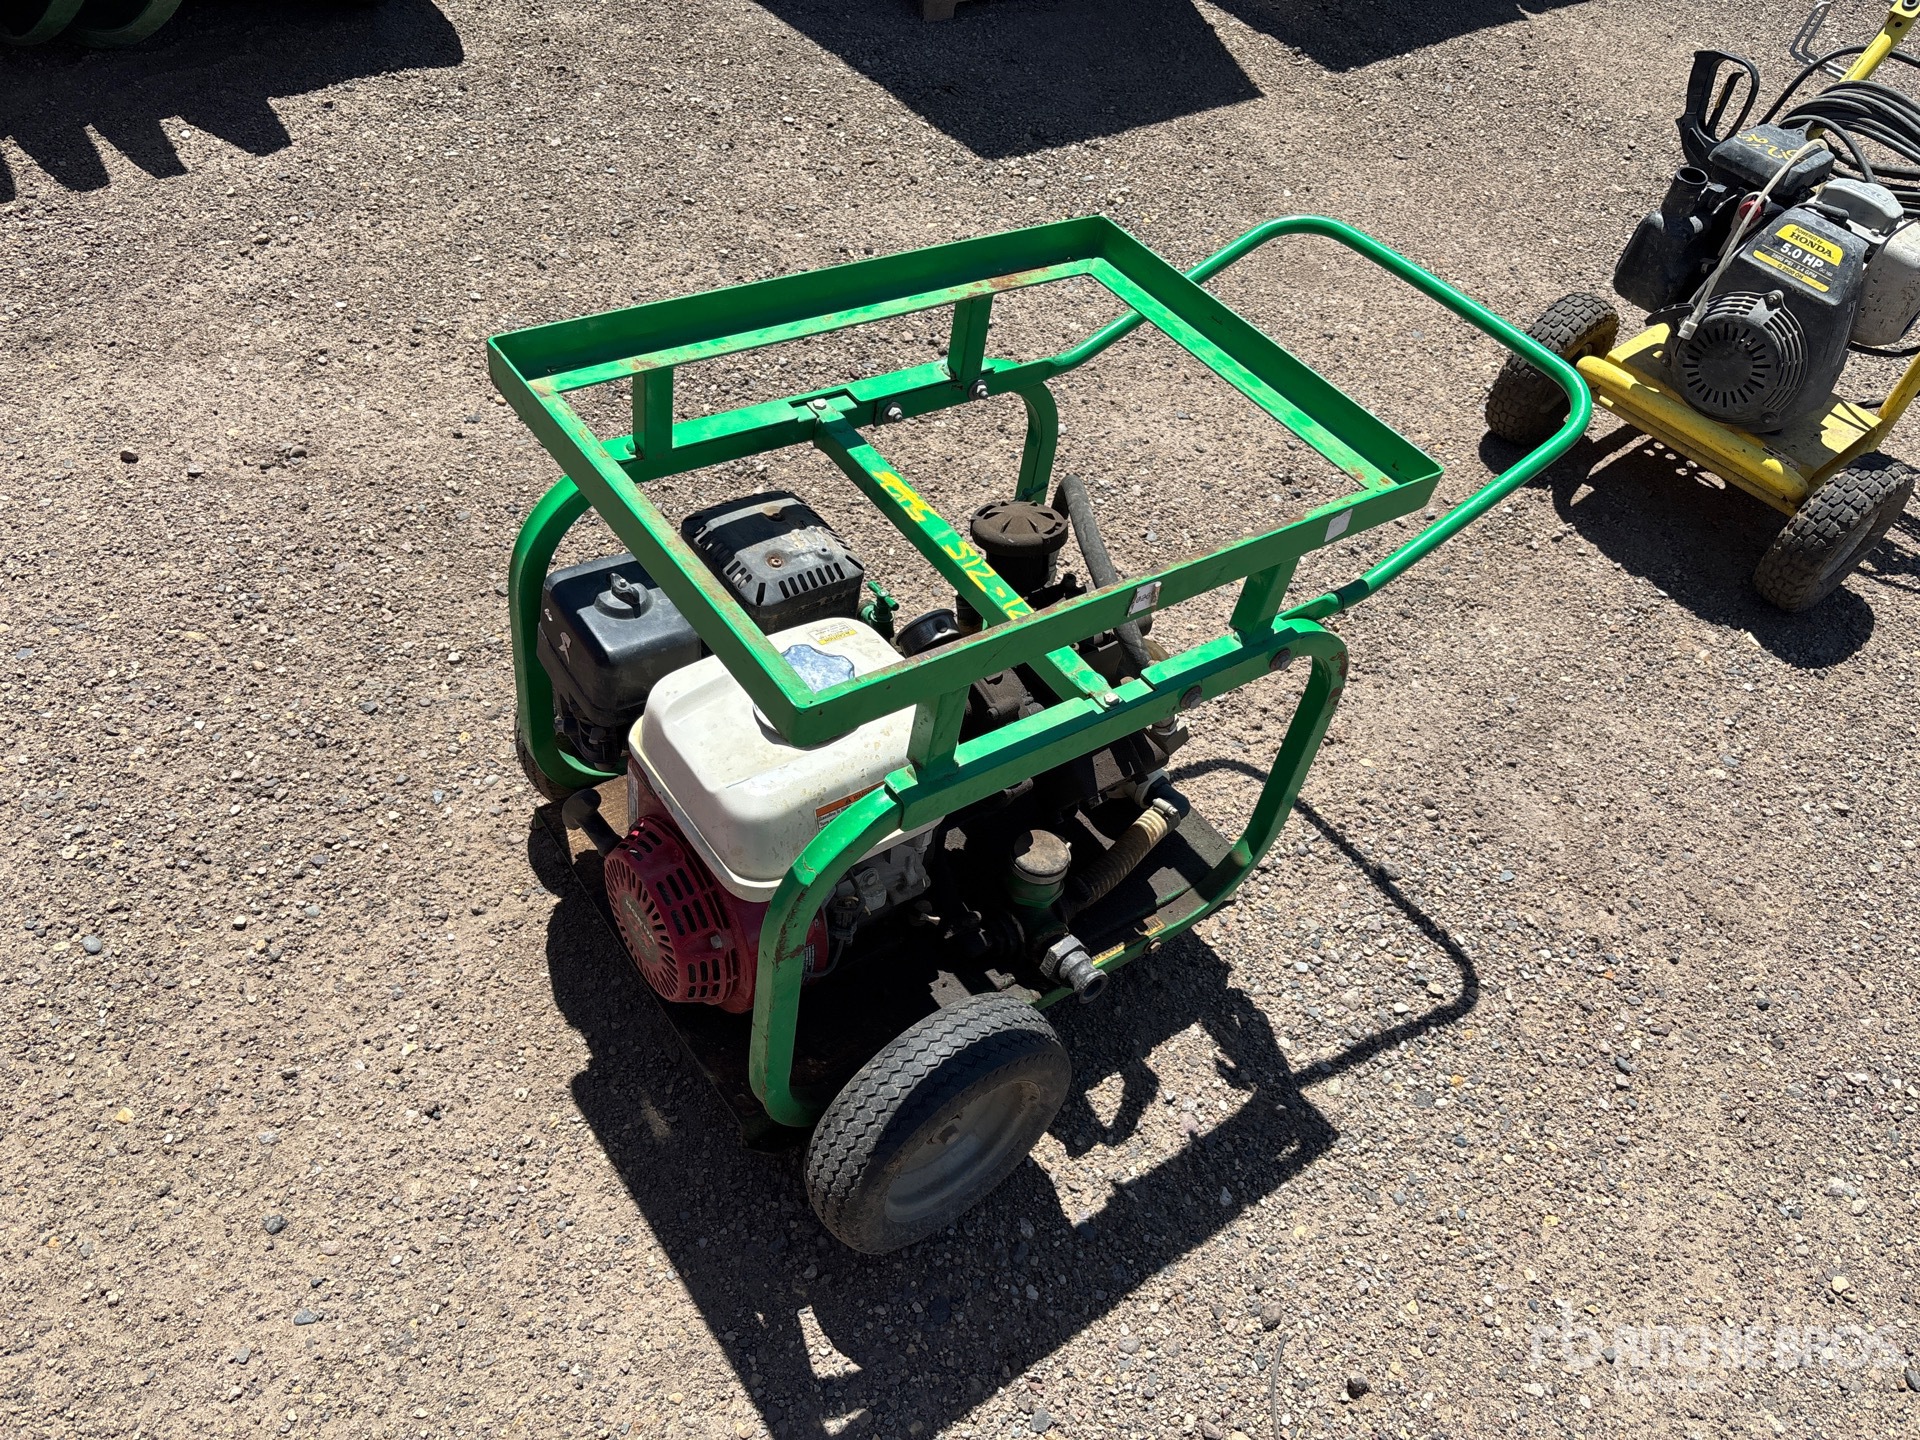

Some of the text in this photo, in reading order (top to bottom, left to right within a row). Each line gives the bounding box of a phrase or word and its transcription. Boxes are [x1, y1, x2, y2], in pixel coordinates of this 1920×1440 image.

[1780, 242, 1824, 269] 5.0 HP
[1789, 232, 1832, 258] HONDA
[1783, 258, 1794, 268] PSI
[1804, 269, 1818, 279] GPM
